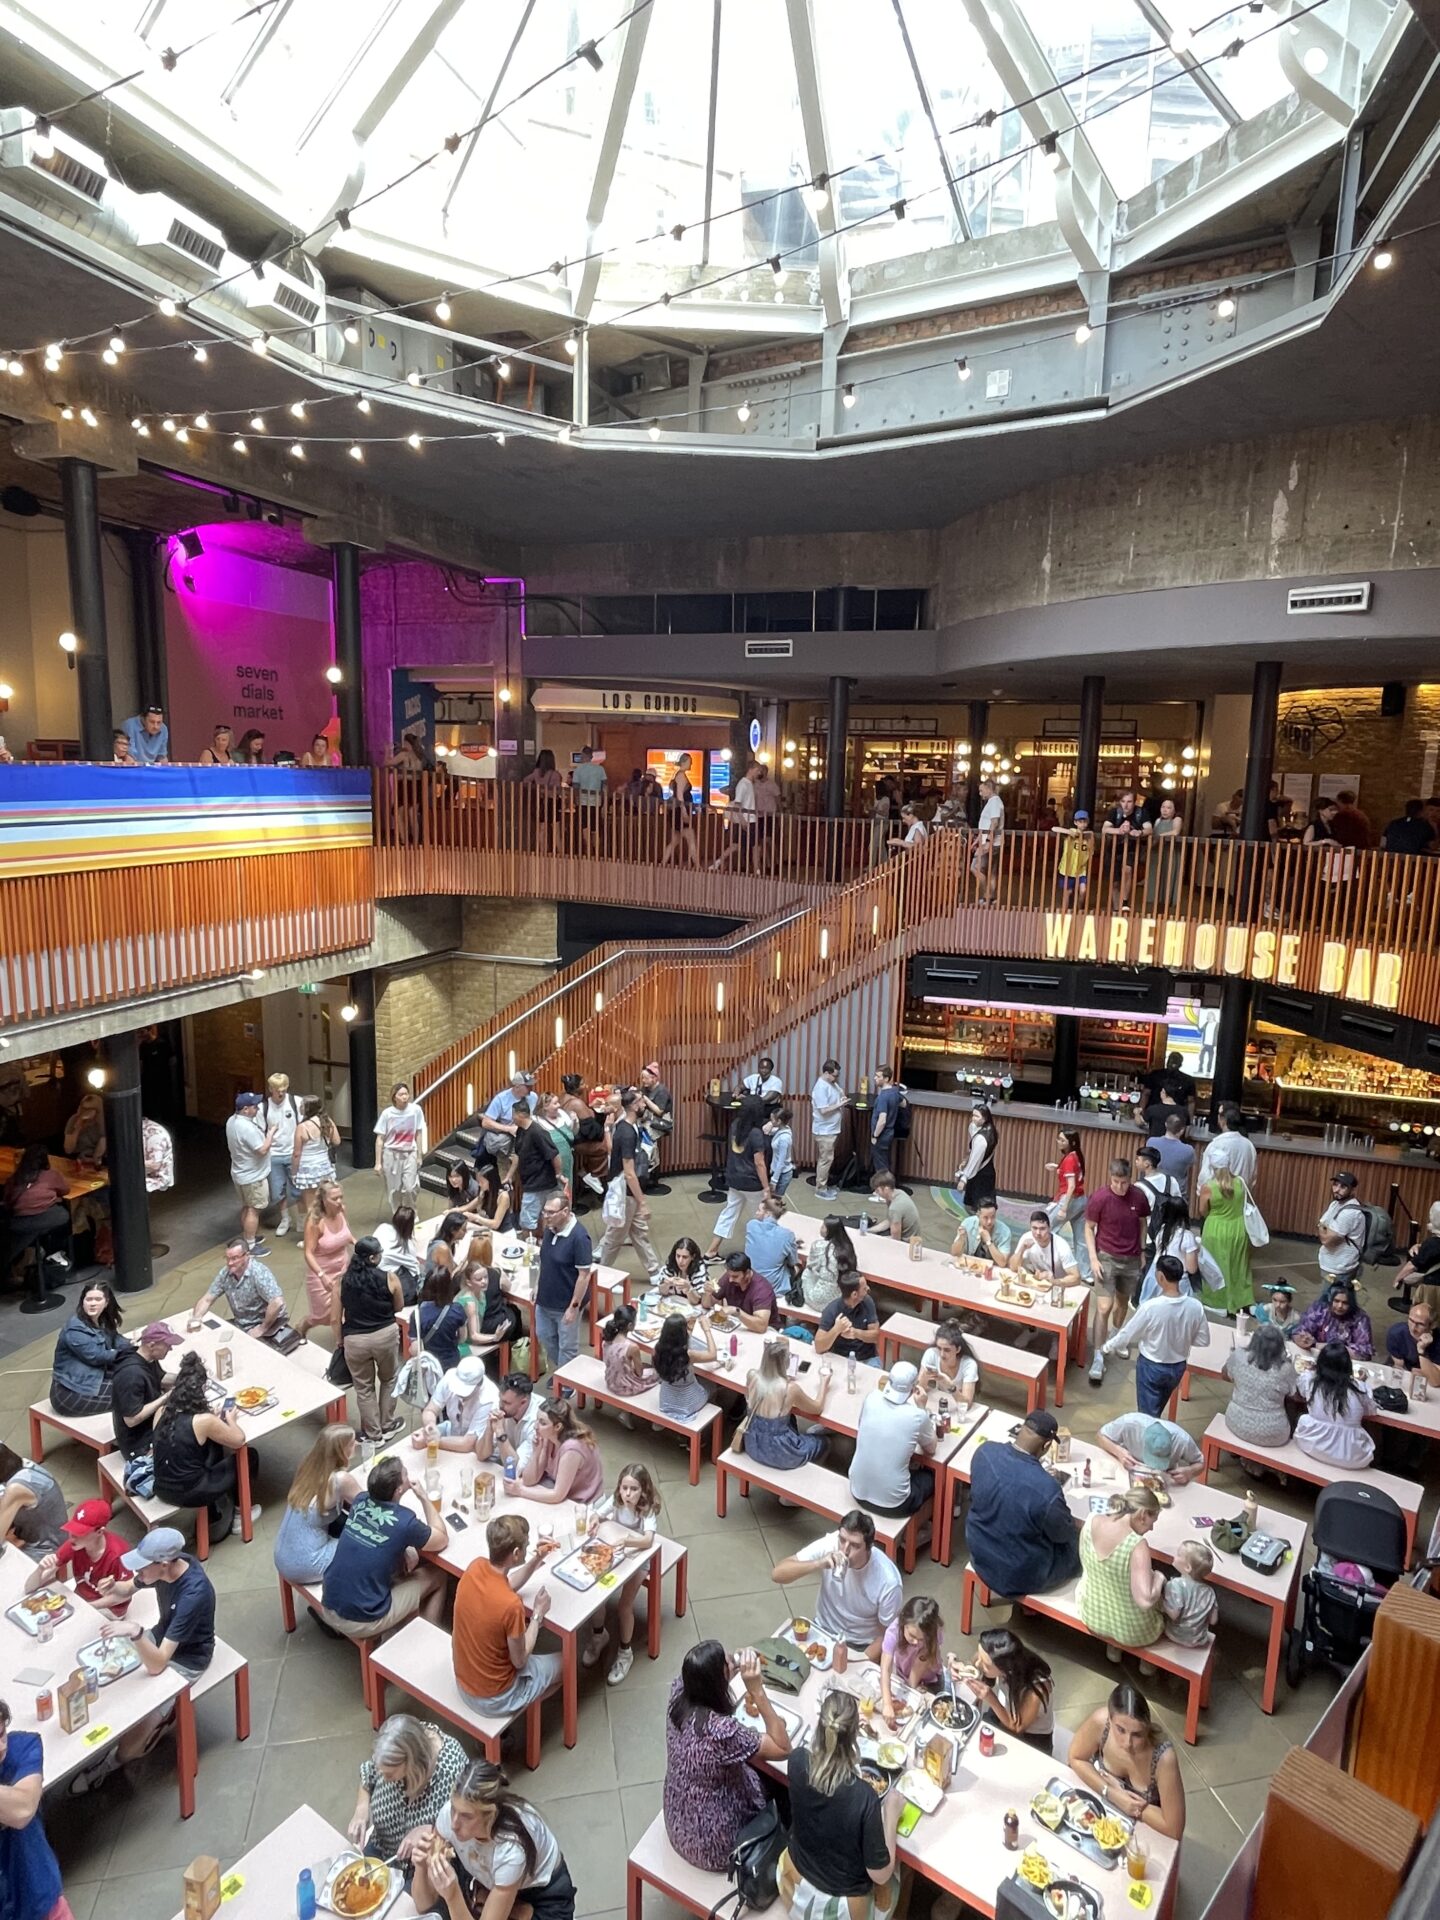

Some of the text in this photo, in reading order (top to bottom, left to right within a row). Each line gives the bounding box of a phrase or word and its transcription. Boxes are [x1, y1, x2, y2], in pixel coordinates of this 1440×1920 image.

[236, 665, 279, 681] seven
[241, 683, 274, 701] dials
[602, 692, 697, 713] LOS GORDOS
[233, 704, 284, 721] market
[1045, 912, 1402, 1009] WAREHOUSE BAR
